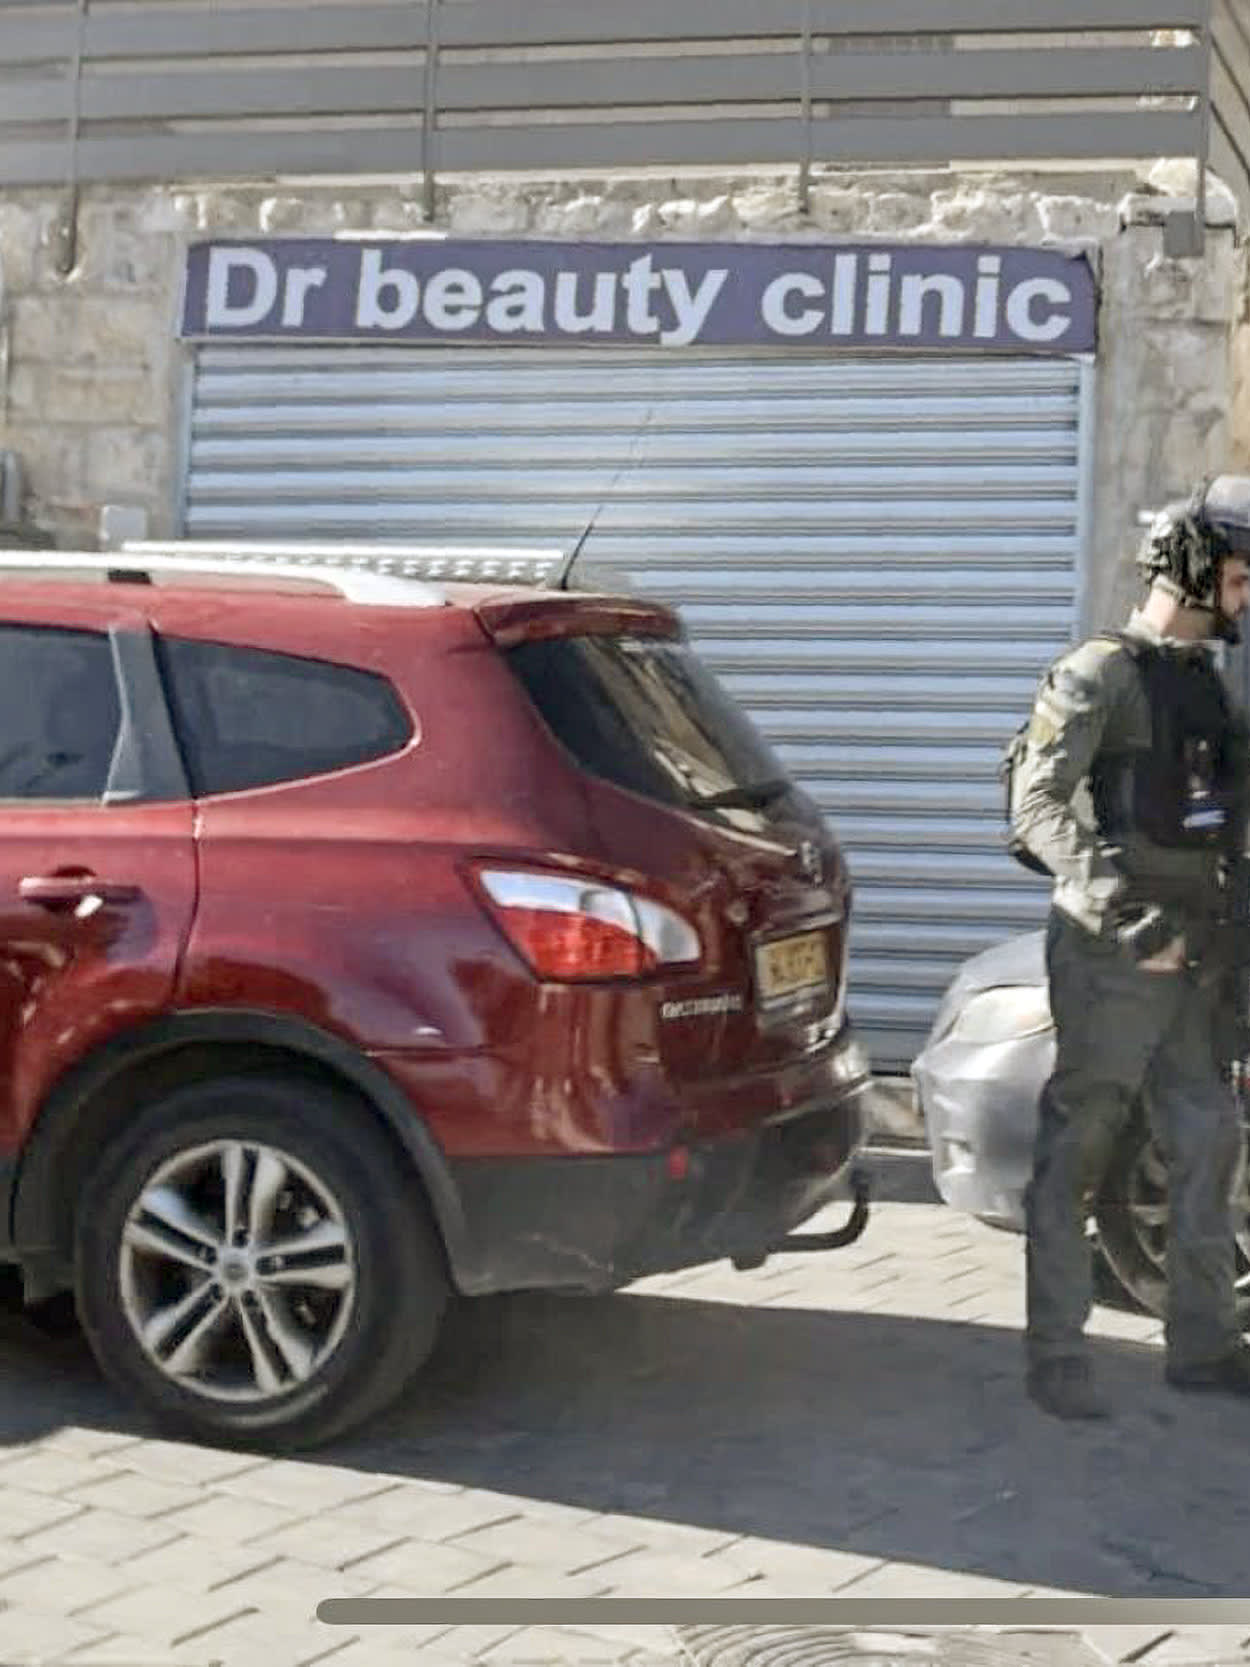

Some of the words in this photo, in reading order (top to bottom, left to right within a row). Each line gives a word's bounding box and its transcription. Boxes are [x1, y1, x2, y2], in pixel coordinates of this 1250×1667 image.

[205, 247, 327, 328] Dr
[354, 249, 729, 347] beauty
[761, 253, 1072, 342] clinic
